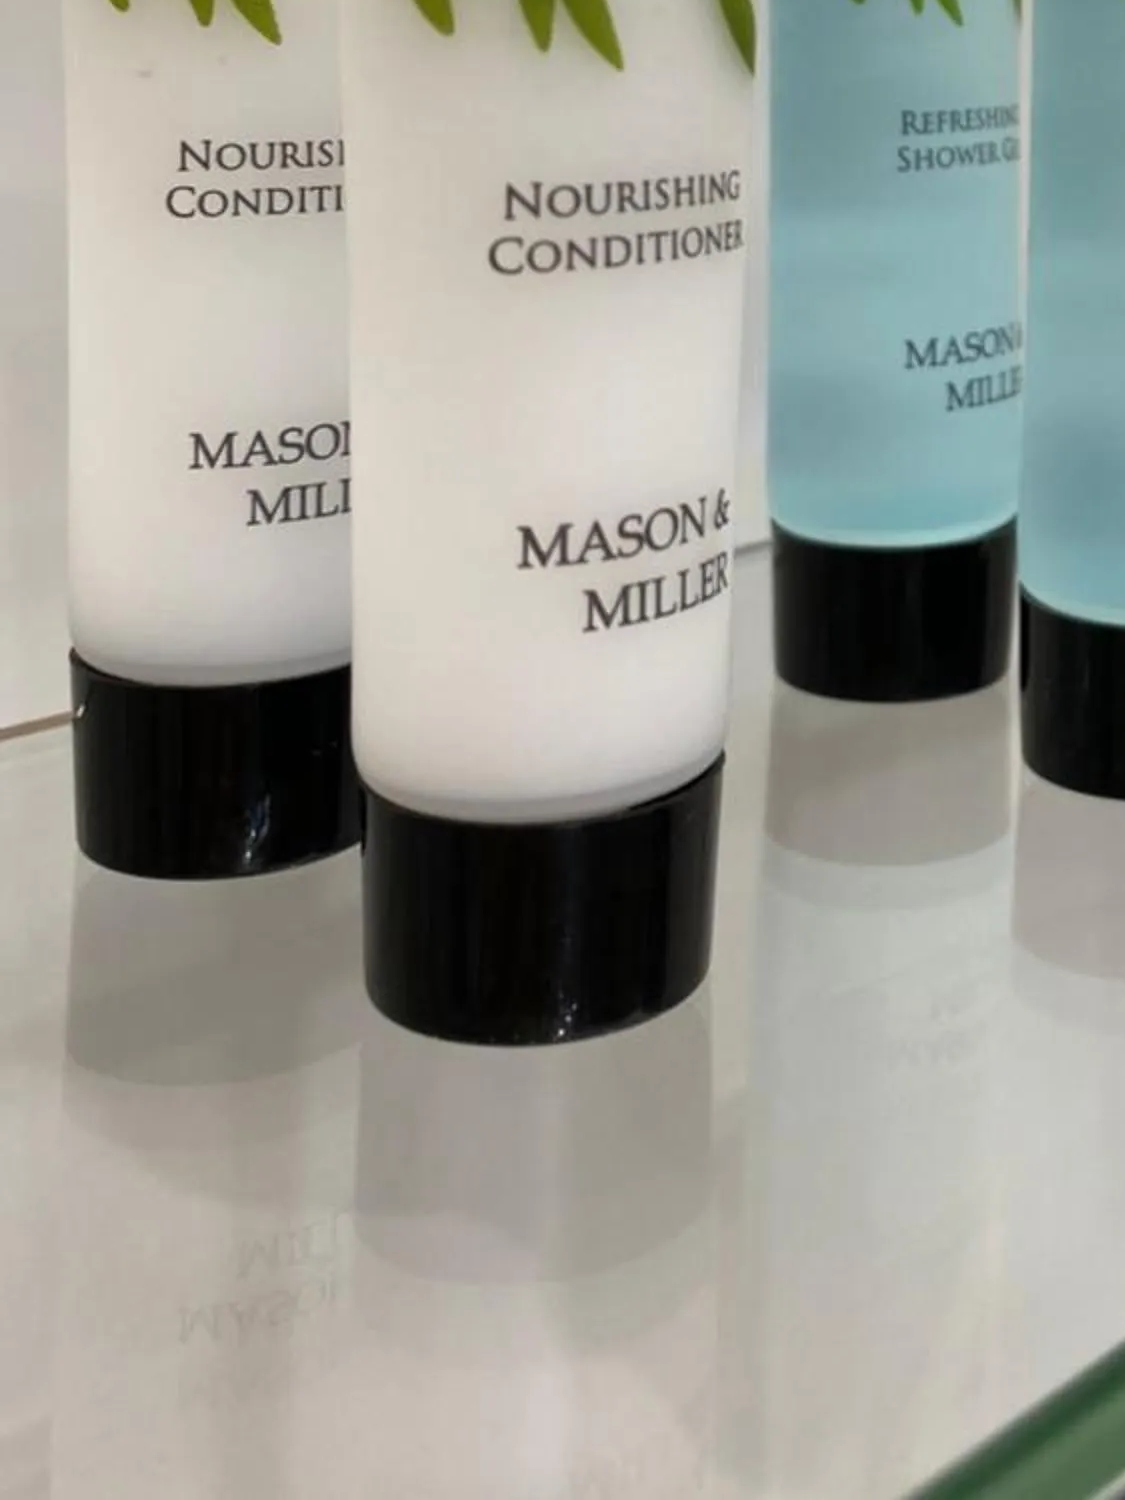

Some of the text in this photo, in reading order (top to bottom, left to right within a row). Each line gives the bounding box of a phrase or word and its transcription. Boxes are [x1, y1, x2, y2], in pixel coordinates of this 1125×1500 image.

[897, 140, 1001, 173] SHOWER
[504, 170, 741, 222] NOURISHING
[488, 218, 744, 276] CONDITIONER
[516, 487, 731, 570] MASON &
[582, 551, 729, 633] MILLER
